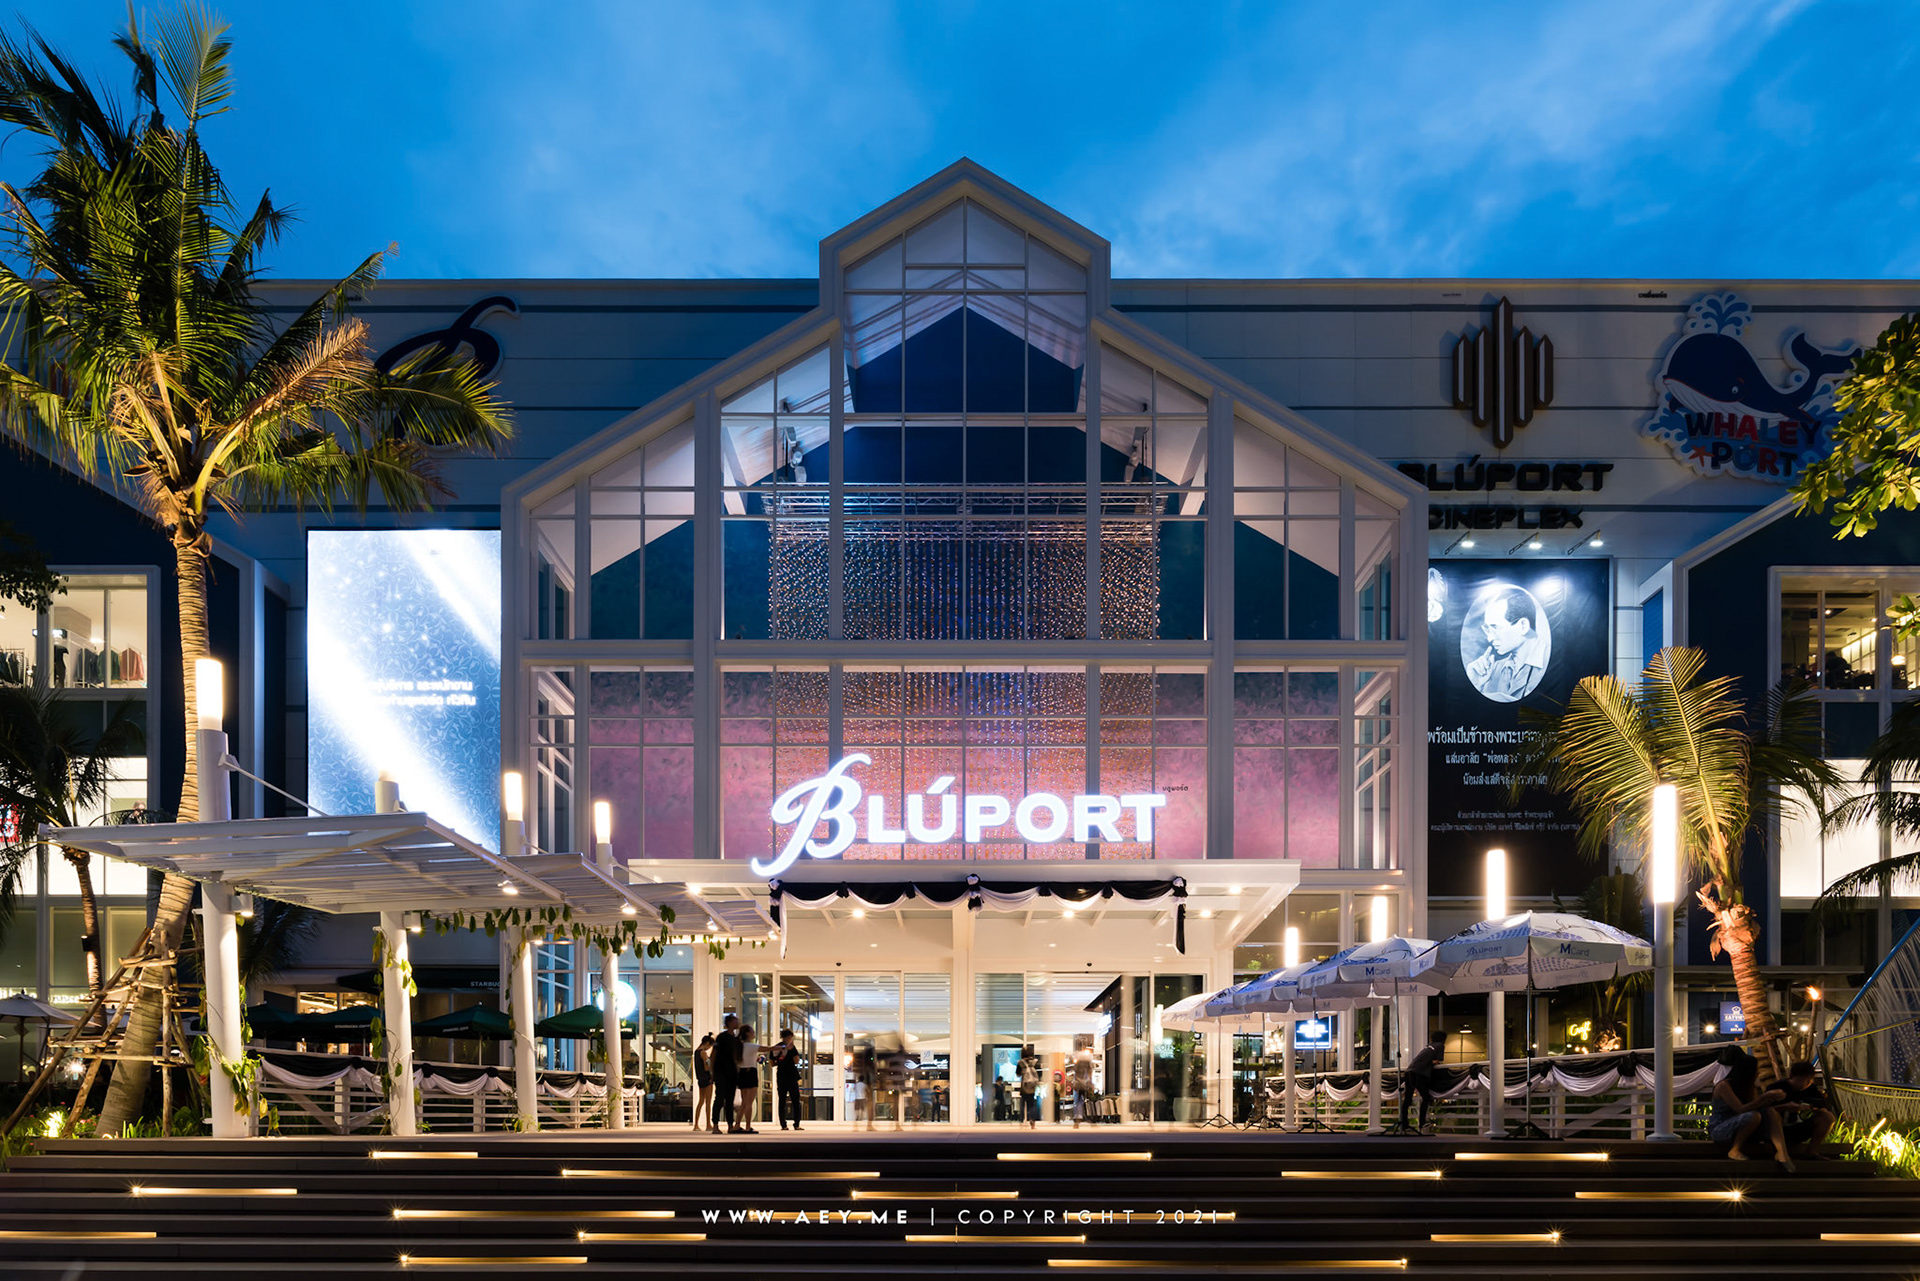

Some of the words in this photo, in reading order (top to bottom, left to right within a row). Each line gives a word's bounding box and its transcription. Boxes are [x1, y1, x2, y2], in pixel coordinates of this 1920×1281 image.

[1685, 412, 1821, 448] WHALEY
[1711, 442, 1797, 476] PORT
[1429, 508, 1583, 530] CINEPLEX
[751, 753, 1167, 877] BLÚPORT
